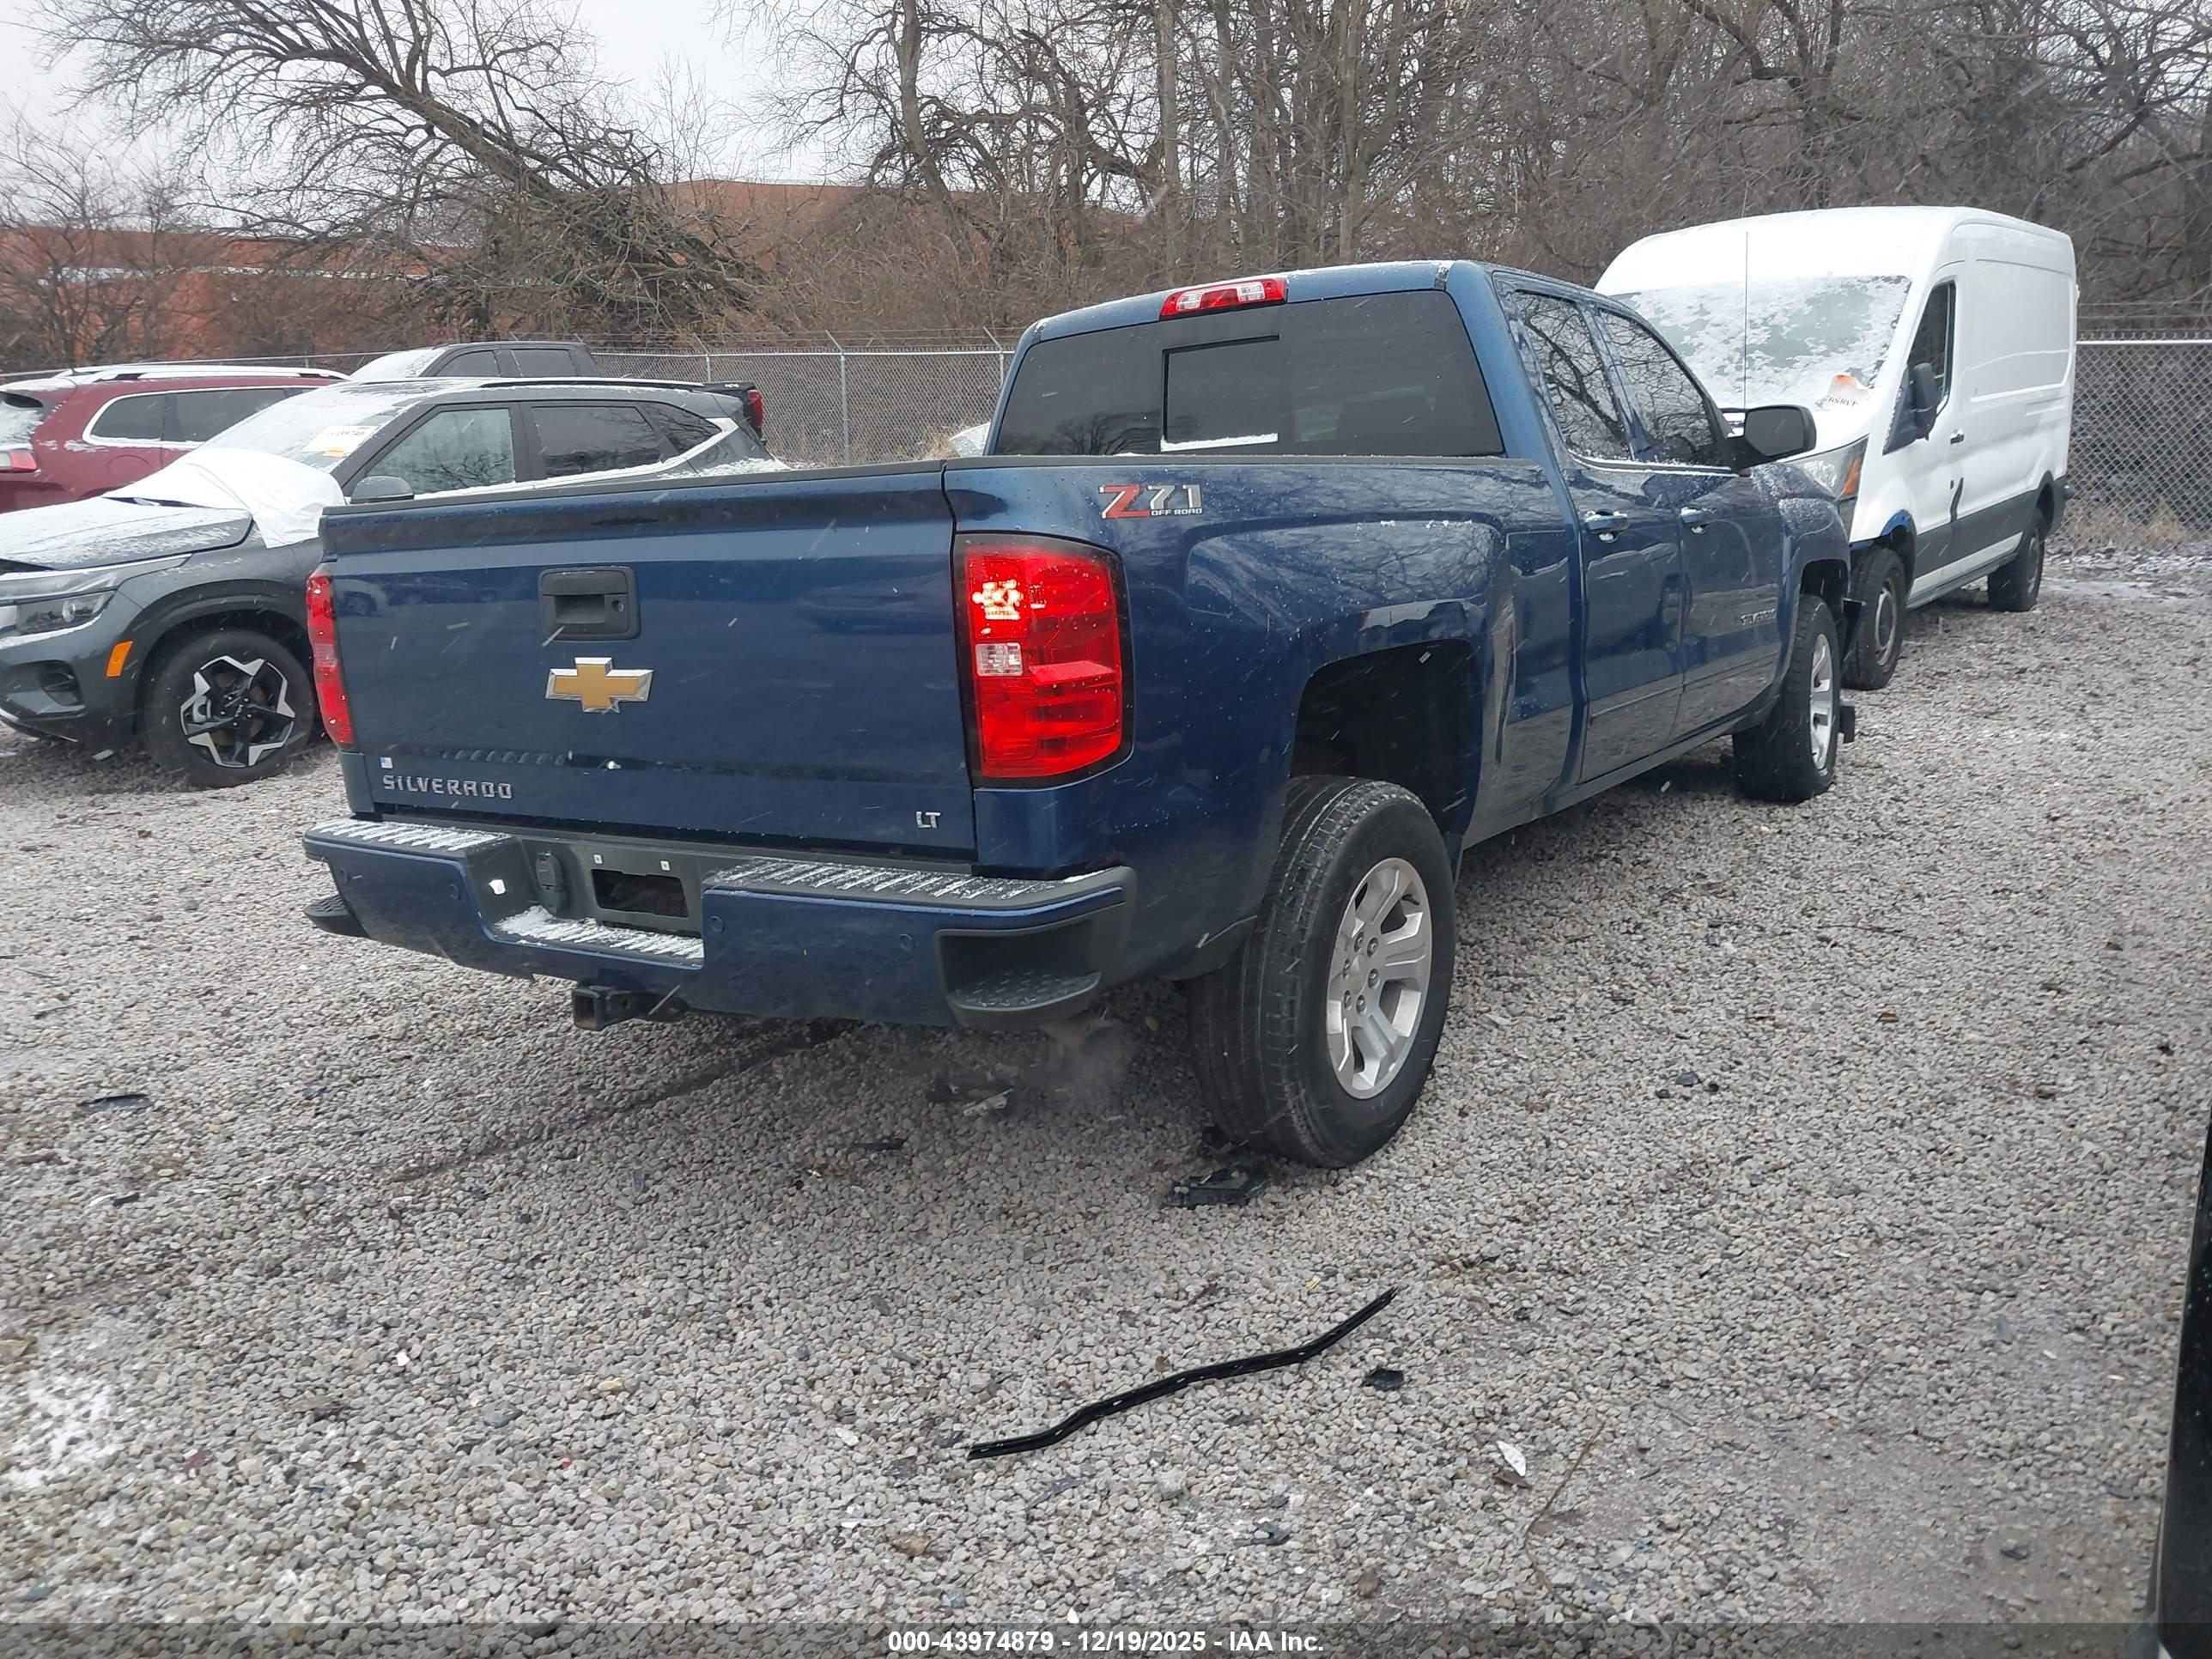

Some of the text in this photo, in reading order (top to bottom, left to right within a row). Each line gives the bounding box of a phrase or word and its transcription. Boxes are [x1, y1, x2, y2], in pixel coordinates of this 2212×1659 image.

[1098, 483, 1203, 520] Z71
[1151, 507, 1203, 517] OFF ROAD
[381, 774, 514, 800] SILVERADO
[915, 811, 942, 830] LT
